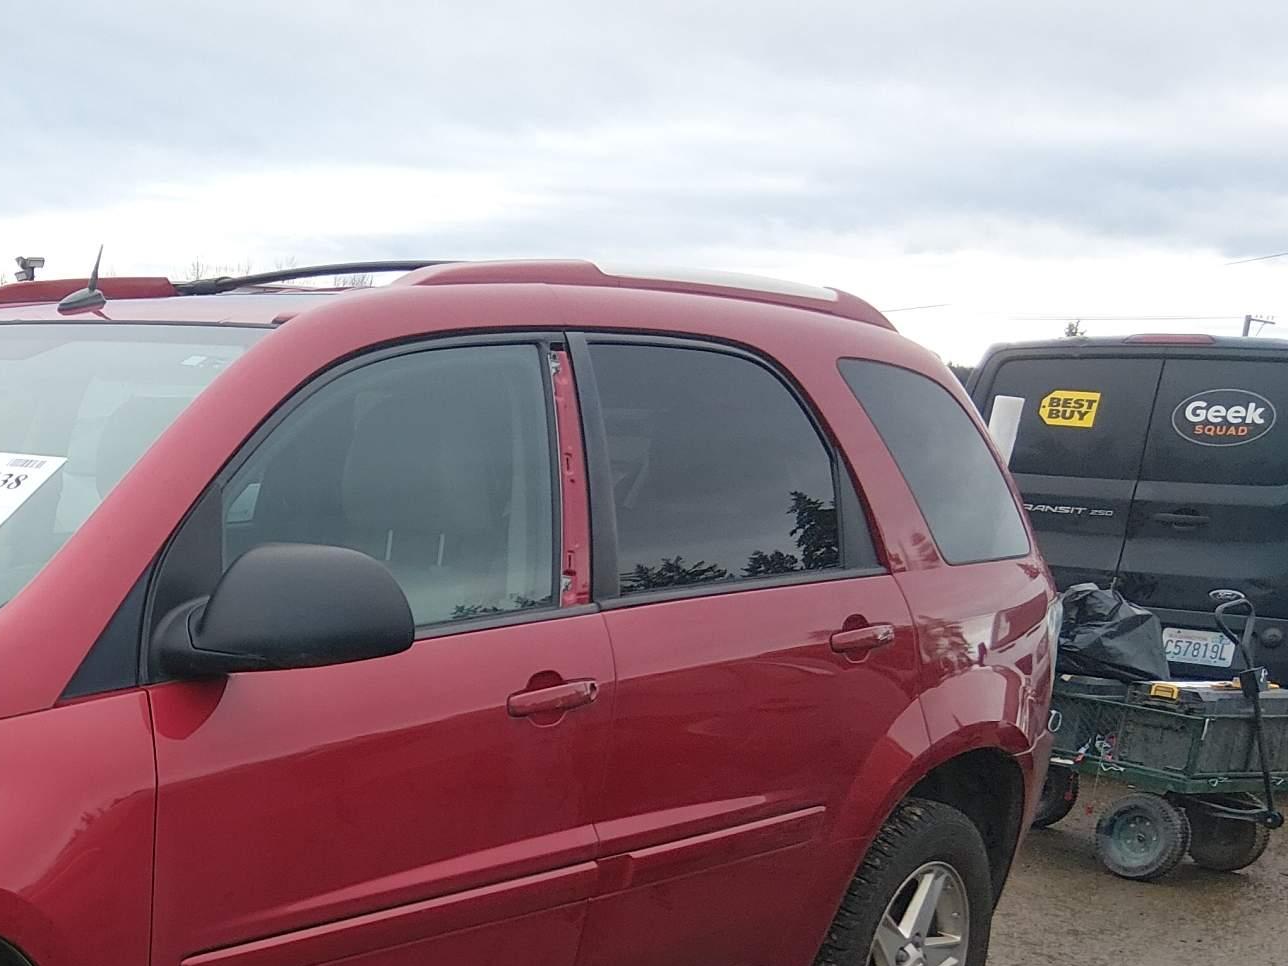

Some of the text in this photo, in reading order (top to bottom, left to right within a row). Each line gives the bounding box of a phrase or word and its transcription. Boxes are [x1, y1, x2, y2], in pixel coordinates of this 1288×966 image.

[1047, 397, 1098, 410] BEST
[1047, 409, 1090, 421] BUY
[1184, 400, 1266, 425] Geek
[1193, 424, 1249, 436] SQUAD
[1023, 503, 1088, 515] RANSIT
[1163, 638, 1227, 661] C57819L
